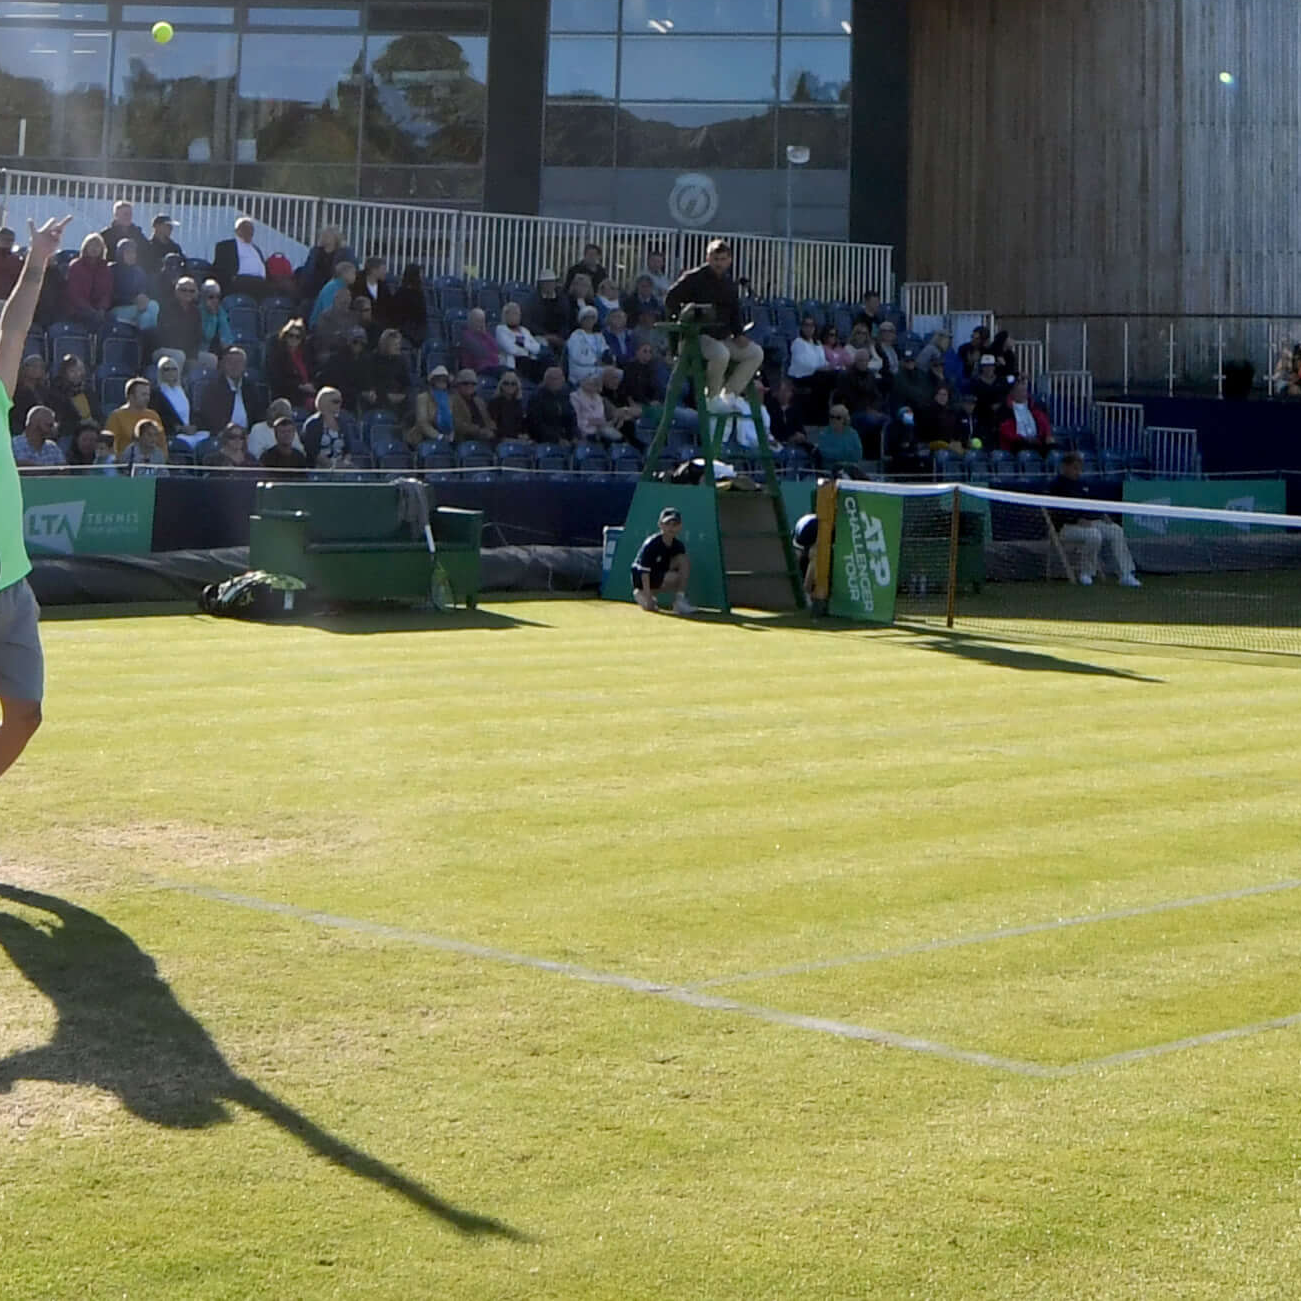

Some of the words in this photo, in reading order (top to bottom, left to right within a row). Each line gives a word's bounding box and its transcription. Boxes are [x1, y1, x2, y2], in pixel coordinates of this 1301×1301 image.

[28, 514, 75, 538] LTA
[87, 513, 139, 524] TENNIS
[844, 496, 874, 612] CHALLENGER
[860, 511, 891, 587] ATP
[843, 553, 860, 602] TOUR
